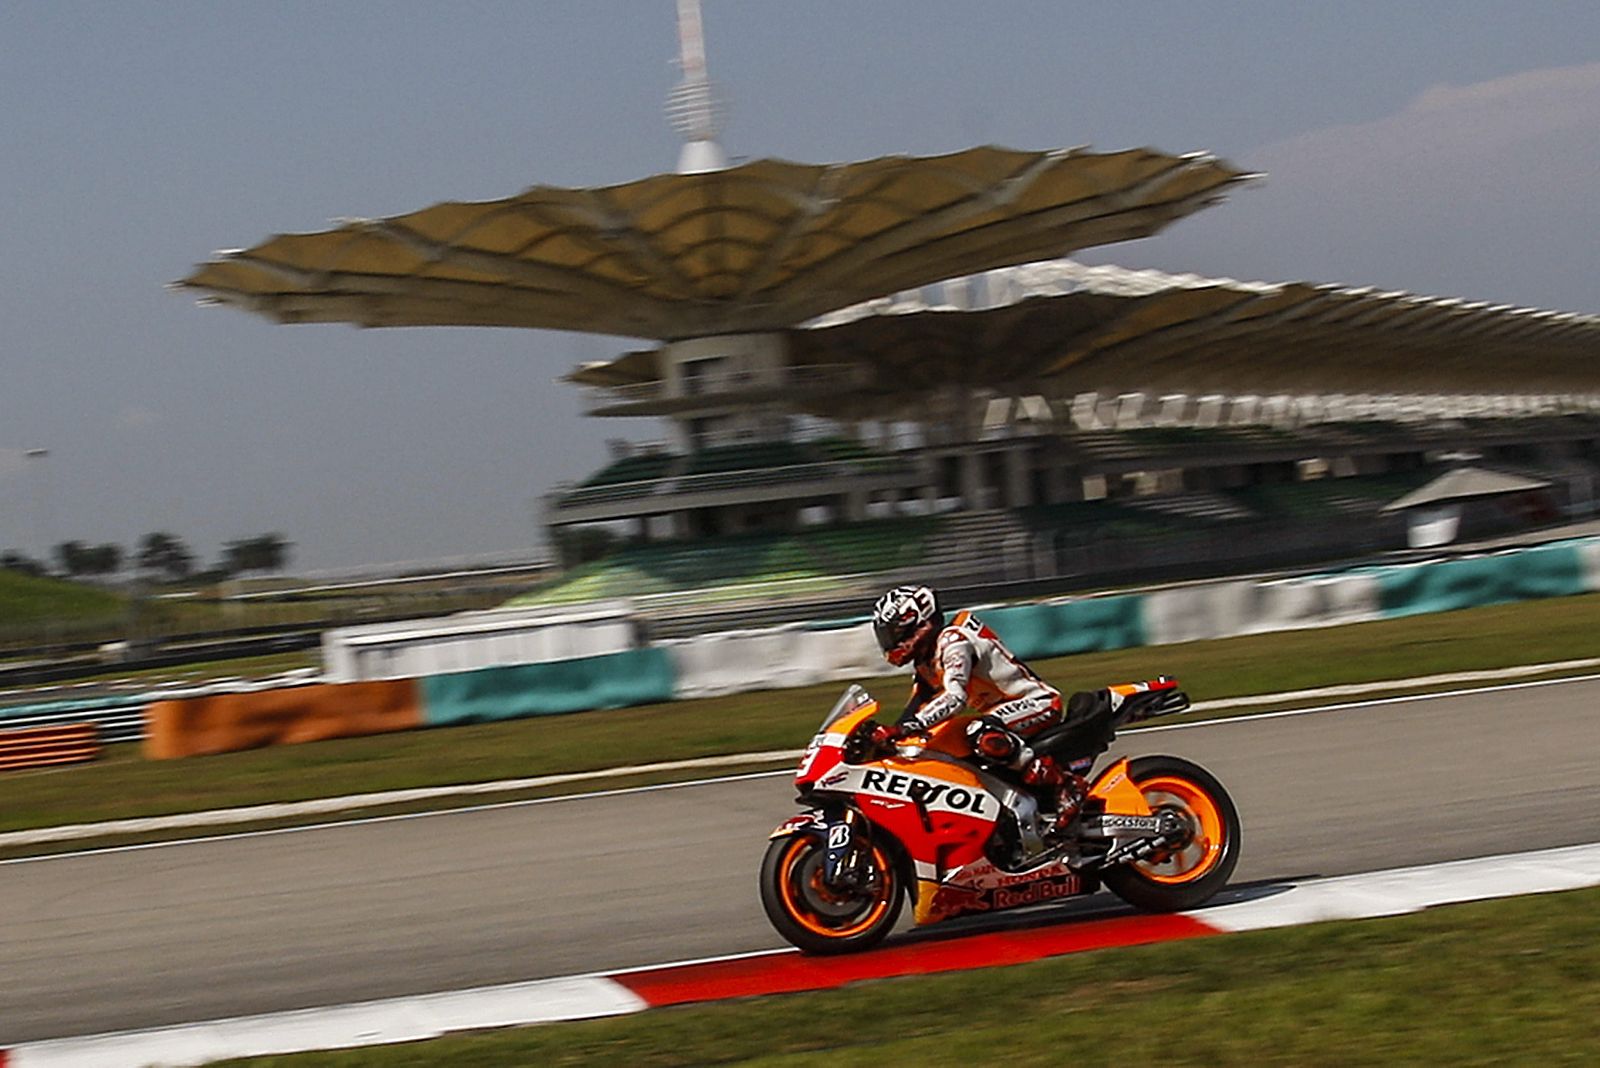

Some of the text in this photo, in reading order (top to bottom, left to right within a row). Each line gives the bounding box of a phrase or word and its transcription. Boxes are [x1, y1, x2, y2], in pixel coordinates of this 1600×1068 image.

[861, 769, 985, 815] REPSOL
[993, 874, 1081, 909] Red Bull
